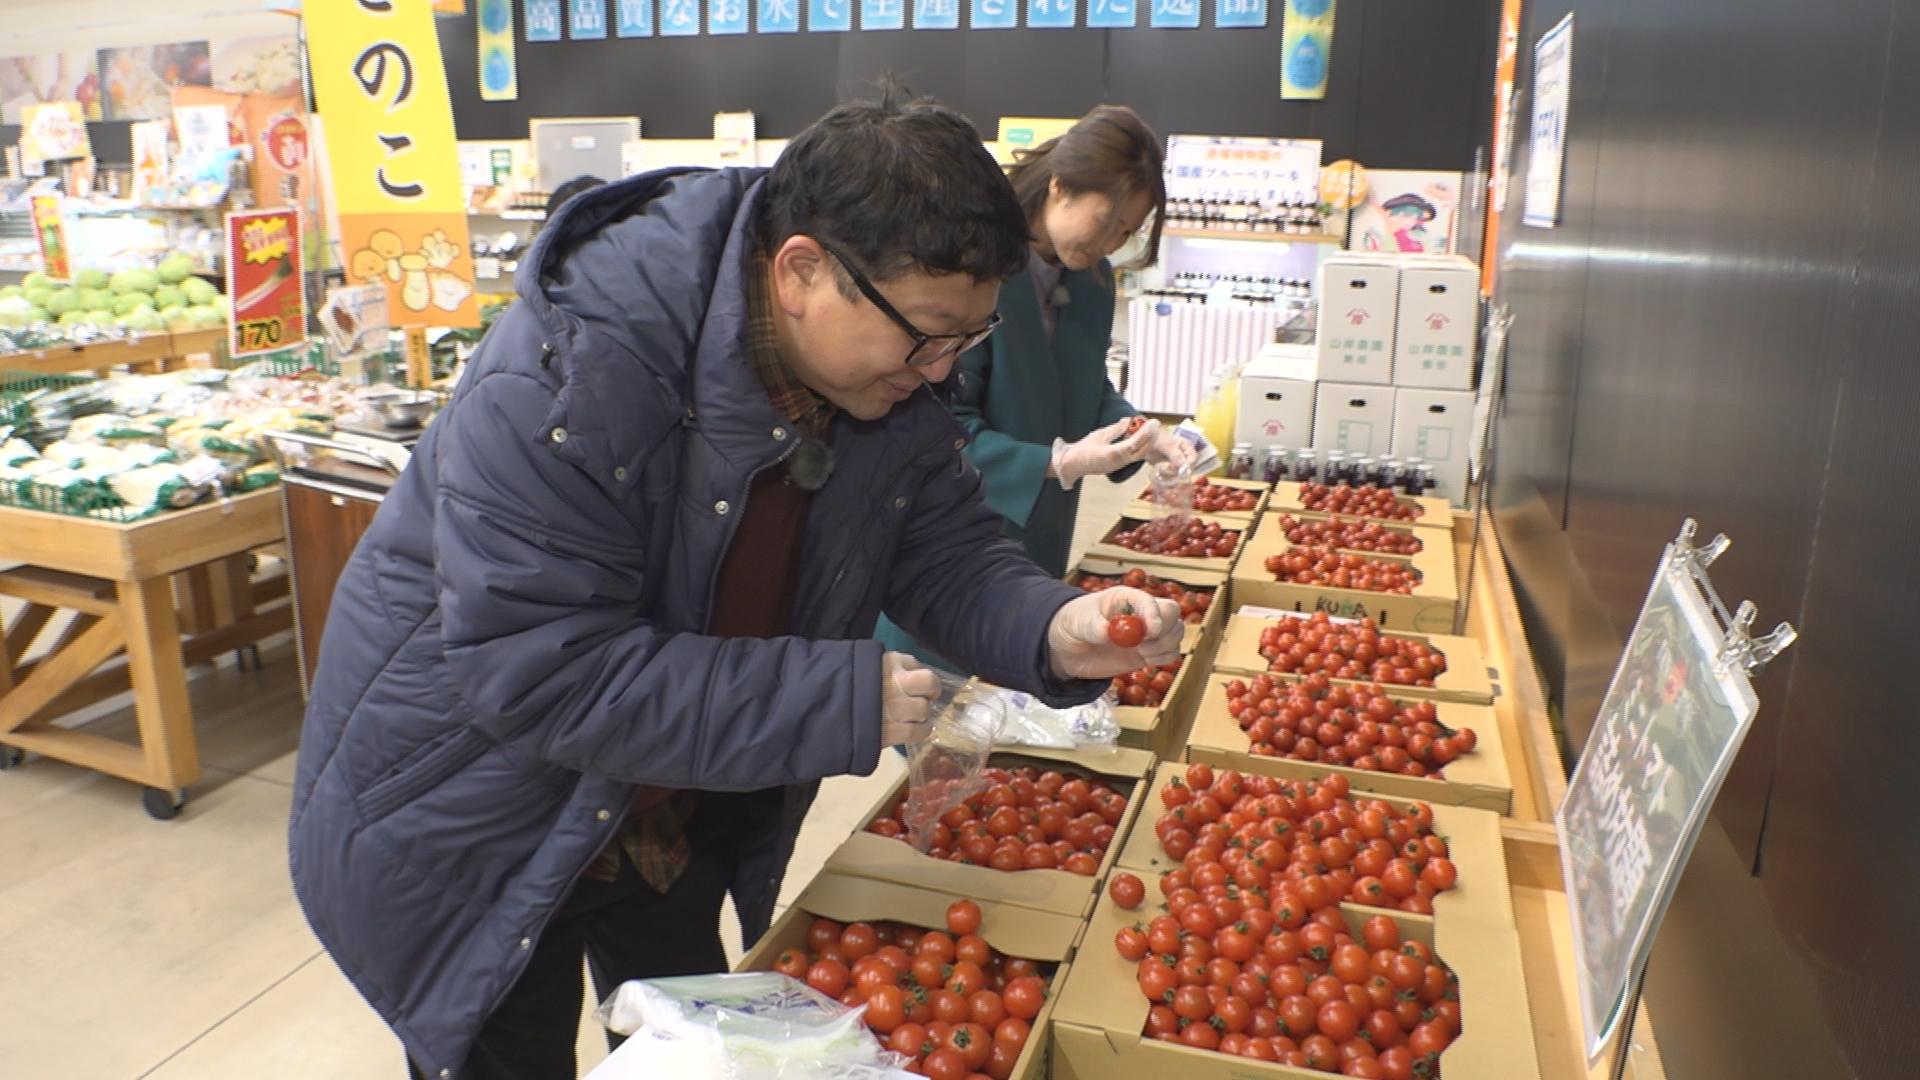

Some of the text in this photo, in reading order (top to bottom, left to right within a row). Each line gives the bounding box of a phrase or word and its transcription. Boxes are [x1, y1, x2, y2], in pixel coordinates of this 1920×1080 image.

[352, 0, 424, 198] のこ
[1177, 165, 1299, 181] 国産ブルーベリーを
[235, 319, 282, 348] 170
